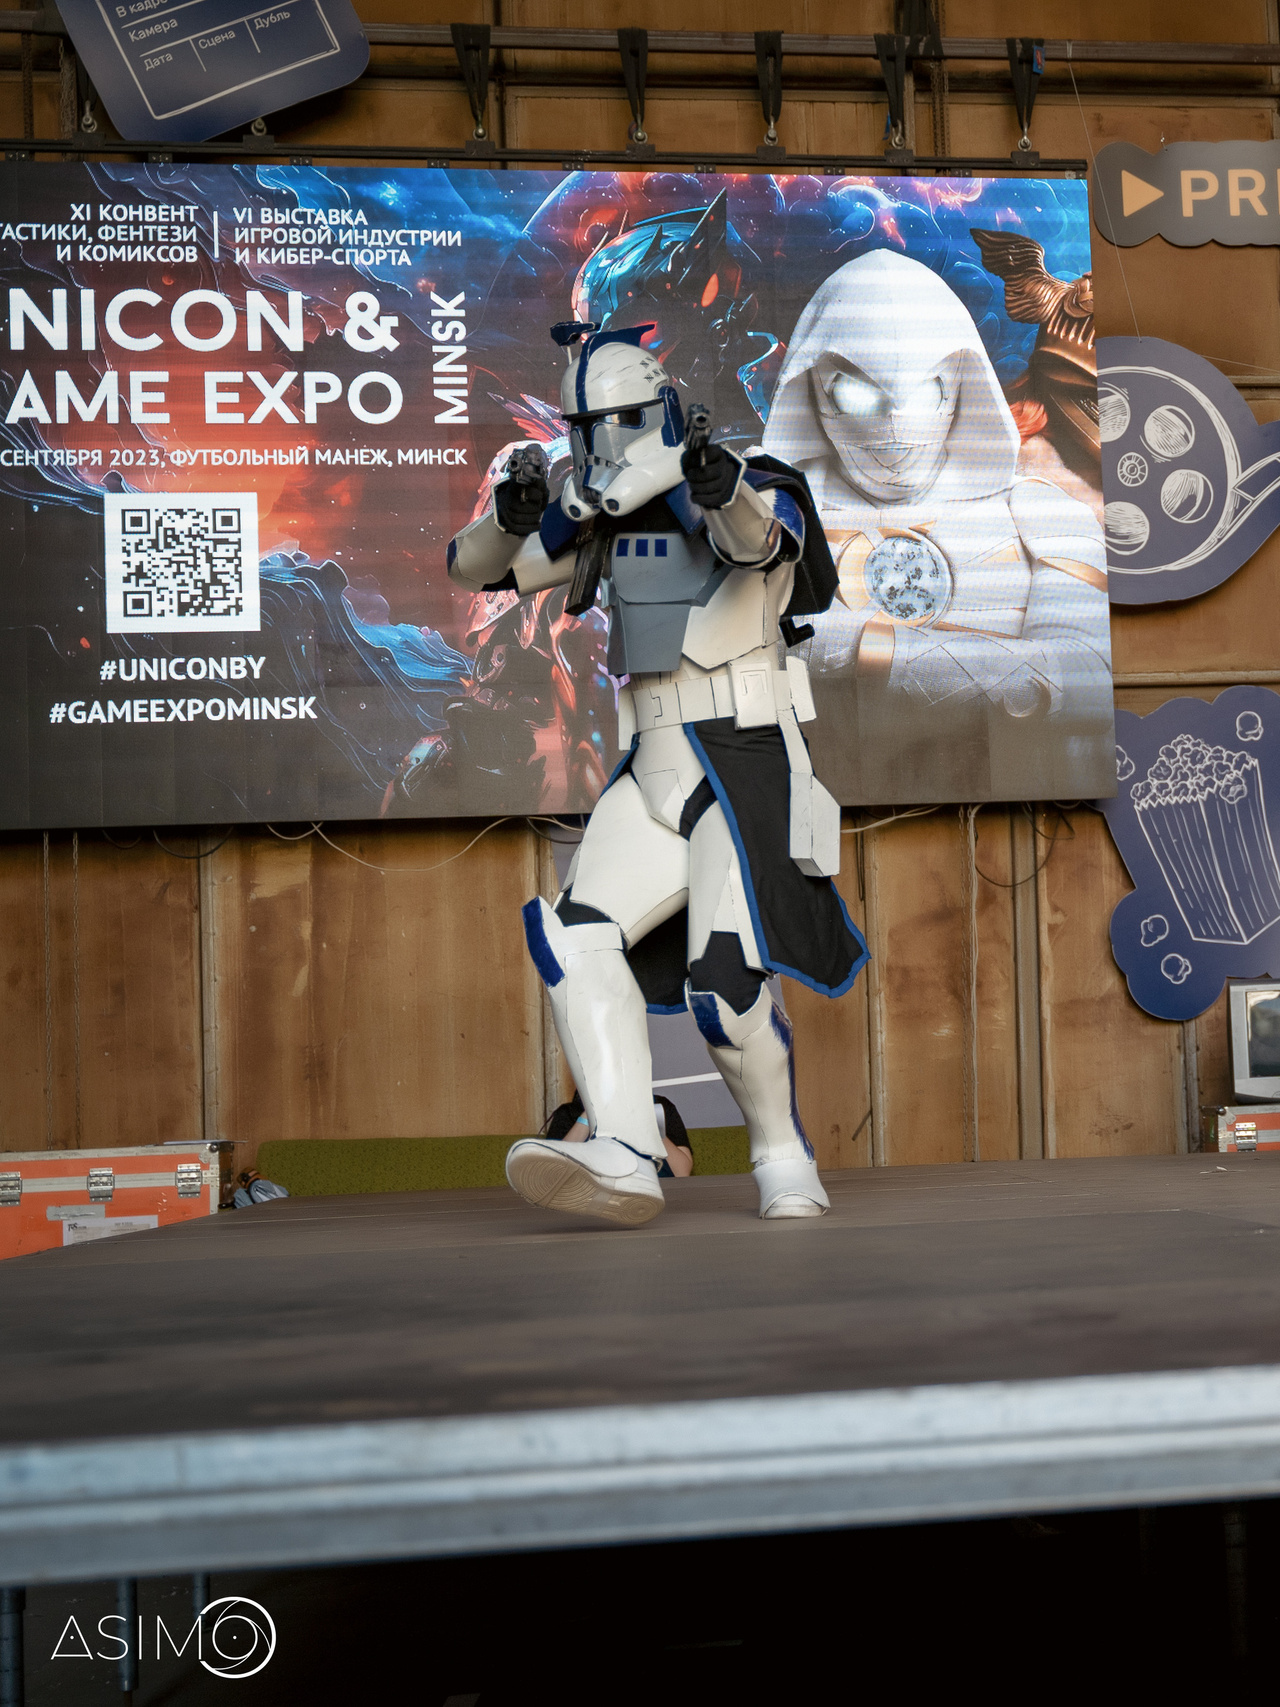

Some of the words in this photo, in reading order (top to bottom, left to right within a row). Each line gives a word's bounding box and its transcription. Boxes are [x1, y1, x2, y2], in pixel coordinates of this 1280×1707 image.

[115, 5, 128, 18] В
[253, 11, 291, 31] Дубль
[128, 18, 179, 42] Камера
[198, 30, 236, 49] Сцена
[143, 52, 173, 71] Дата
[70, 203, 92, 221] XI
[98, 203, 199, 222] КОНВЕНТ
[233, 207, 252, 224] VI
[260, 207, 368, 226] ВЫСТАВКА
[0, 223, 93, 243] АСТИКИ,
[97, 224, 197, 242] ФЕНТЕЗИ
[234, 224, 332, 245] ИГРОВОЙ
[338, 229, 462, 247] ИНДУСТРИИ
[56, 244, 71, 262] И
[78, 245, 198, 263] КОМИКСОВ
[235, 247, 250, 264] И
[256, 247, 412, 266] КИБЕР-СПОРТА
[8, 288, 304, 352] NICON
[343, 291, 400, 353] &
[430, 291, 470, 425] MINSK
[4, 369, 171, 425] AME
[204, 371, 404, 425] EXPO
[0, 448, 103, 467] СЕНТЯБРЯ
[109, 448, 166, 468] 2023,
[169, 445, 310, 466] ФУТБОЛЬНЫЙ
[314, 448, 393, 468] МАНЕЖ,
[397, 448, 468, 466] МИНСК
[99, 656, 267, 681] #UNICONBY
[49, 696, 318, 724] #GAMEEXPOMINSK
